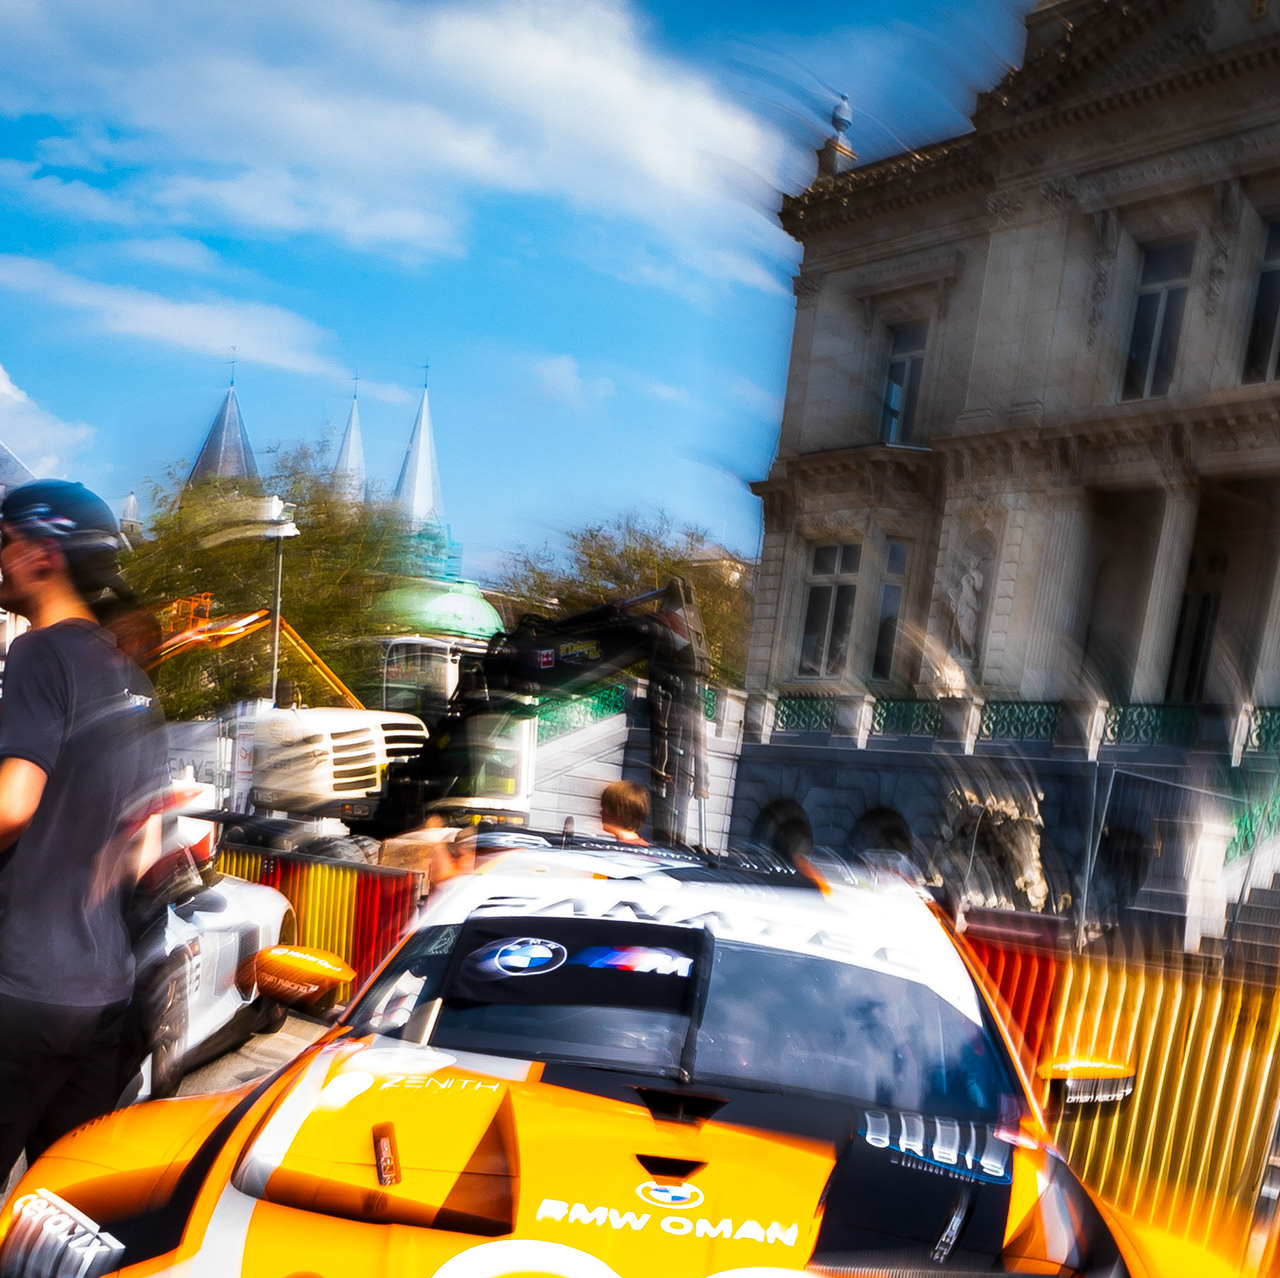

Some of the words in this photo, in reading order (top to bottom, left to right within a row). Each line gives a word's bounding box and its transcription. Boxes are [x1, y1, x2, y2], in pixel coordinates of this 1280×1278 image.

[379, 1074, 500, 1092] ZENITH
[864, 1111, 1007, 1177] ORBIS
[536, 1198, 651, 1231] BMW
[660, 1216, 799, 1247] OMAN
